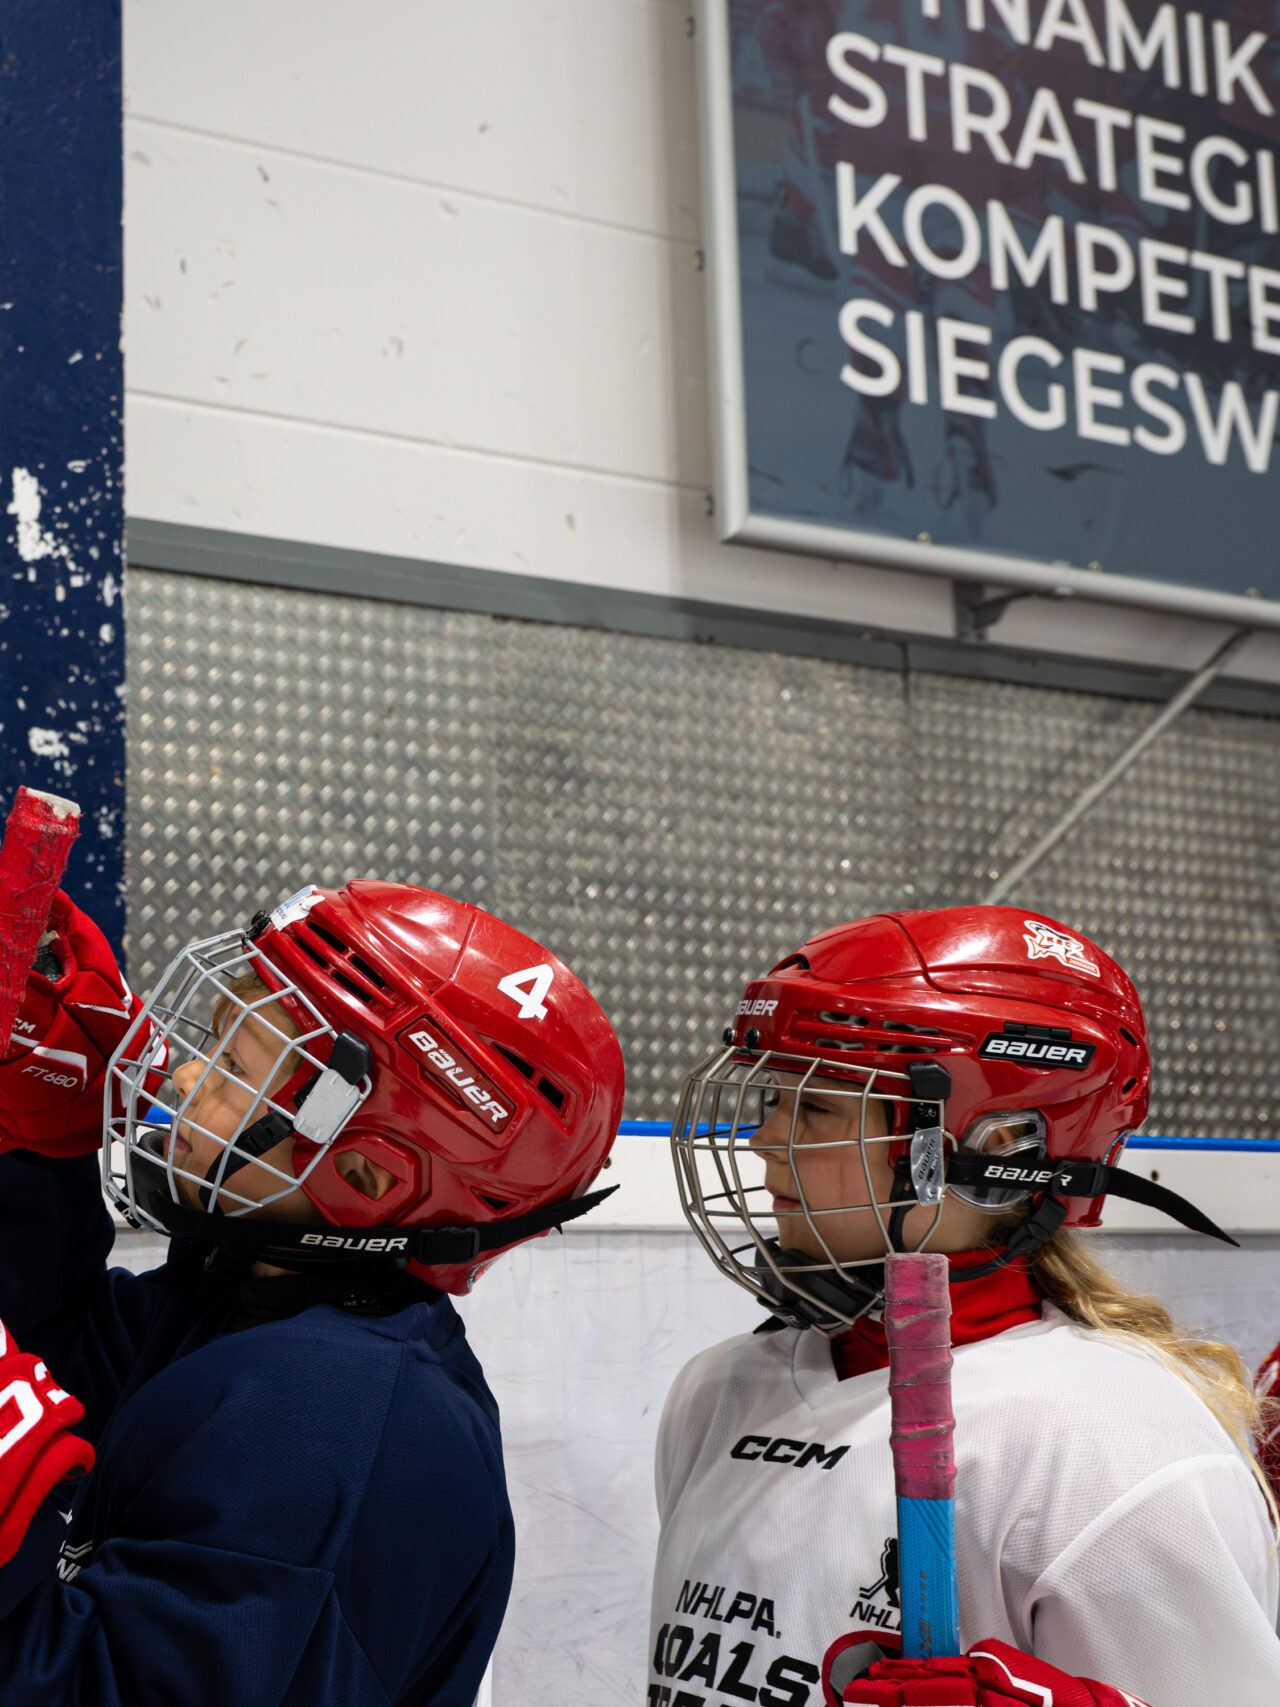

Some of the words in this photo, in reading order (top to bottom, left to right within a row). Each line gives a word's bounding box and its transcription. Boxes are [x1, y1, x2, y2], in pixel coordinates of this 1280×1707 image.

[922, 0, 1275, 116] AMIK
[826, 32, 1279, 233] STRATEGI
[835, 162, 1280, 357] KOMPETE
[838, 299, 1280, 474] SIEGESW
[497, 964, 554, 1021] 4
[730, 1435, 851, 1470] CCM
